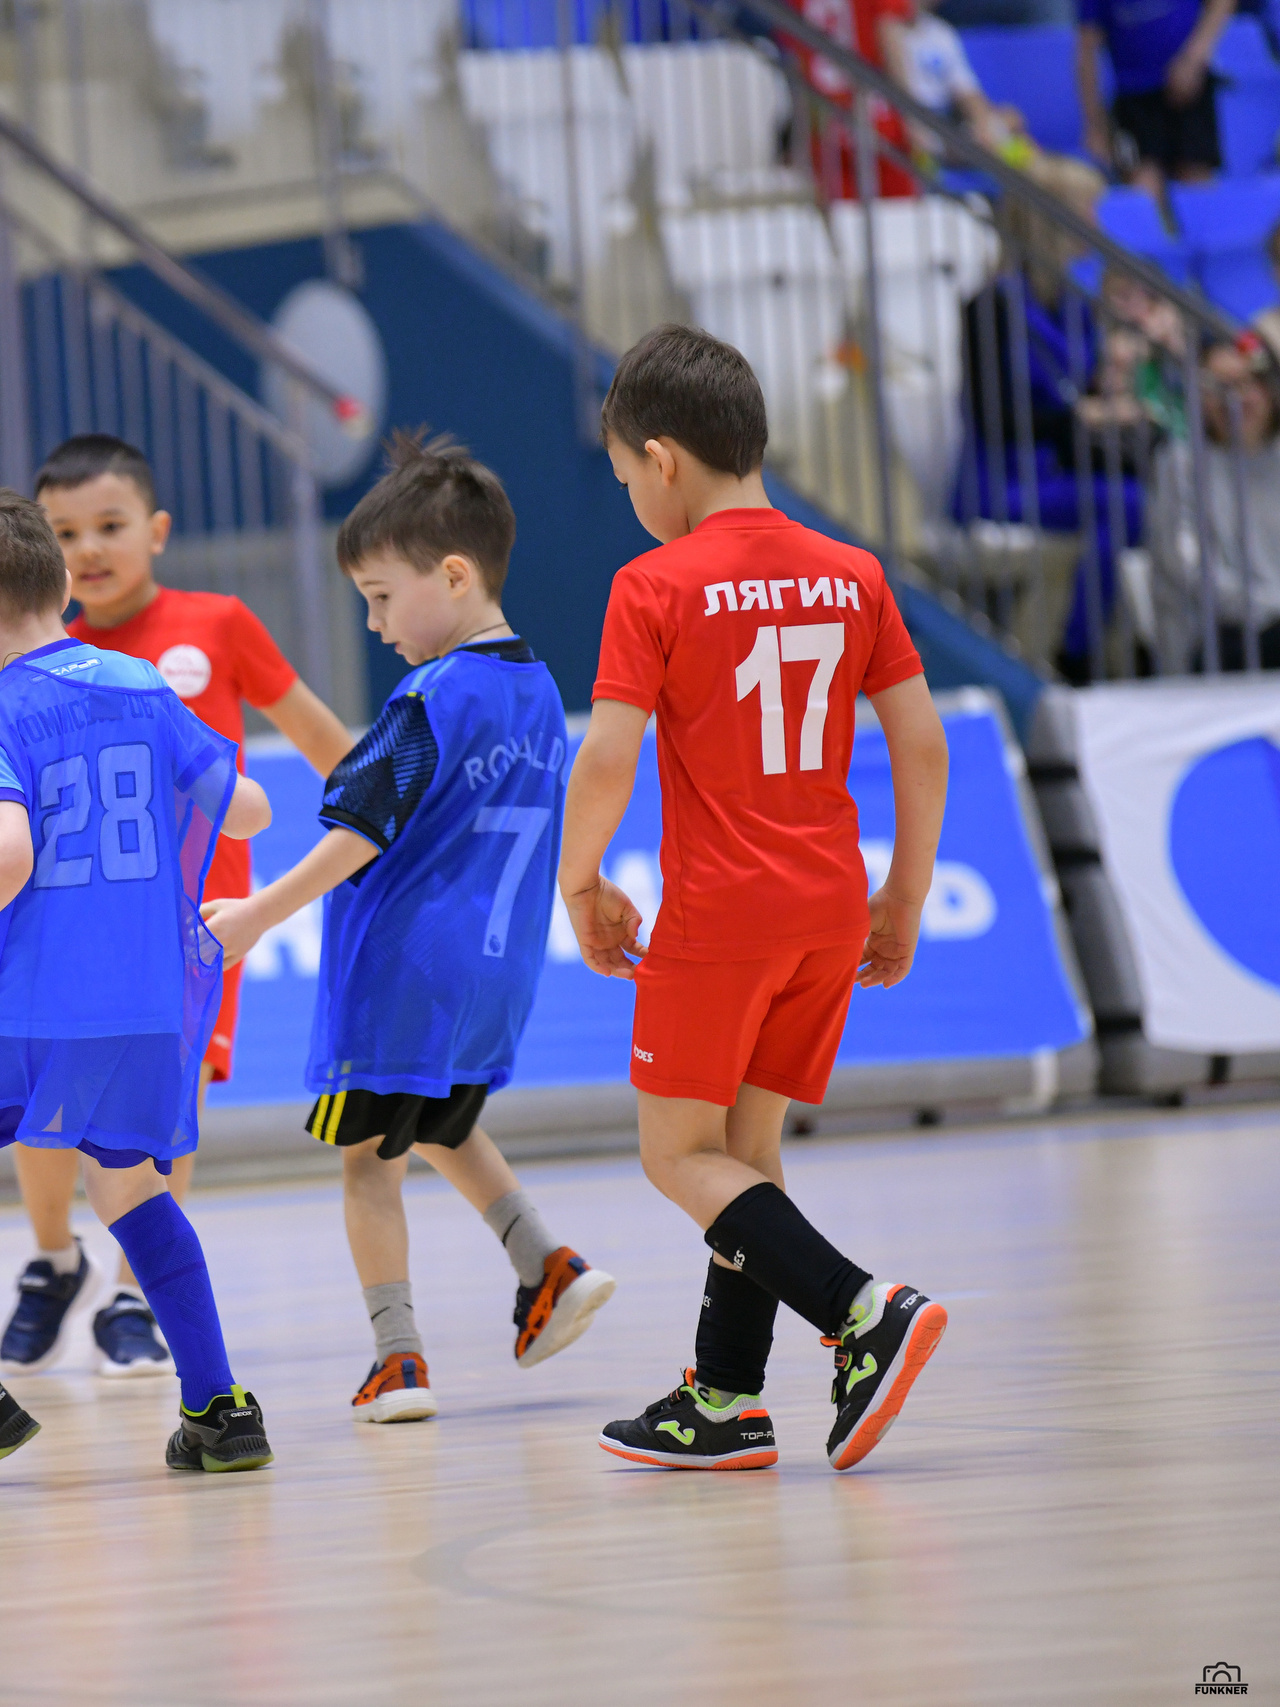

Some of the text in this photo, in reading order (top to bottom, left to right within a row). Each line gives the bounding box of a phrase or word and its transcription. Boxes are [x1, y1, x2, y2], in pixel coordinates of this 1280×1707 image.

[704, 577, 861, 617] ЛЯГИН
[464, 731, 567, 791] RONALD
[735, 622, 845, 775] 17
[33, 740, 160, 890] 28
[473, 806, 552, 958] 7
